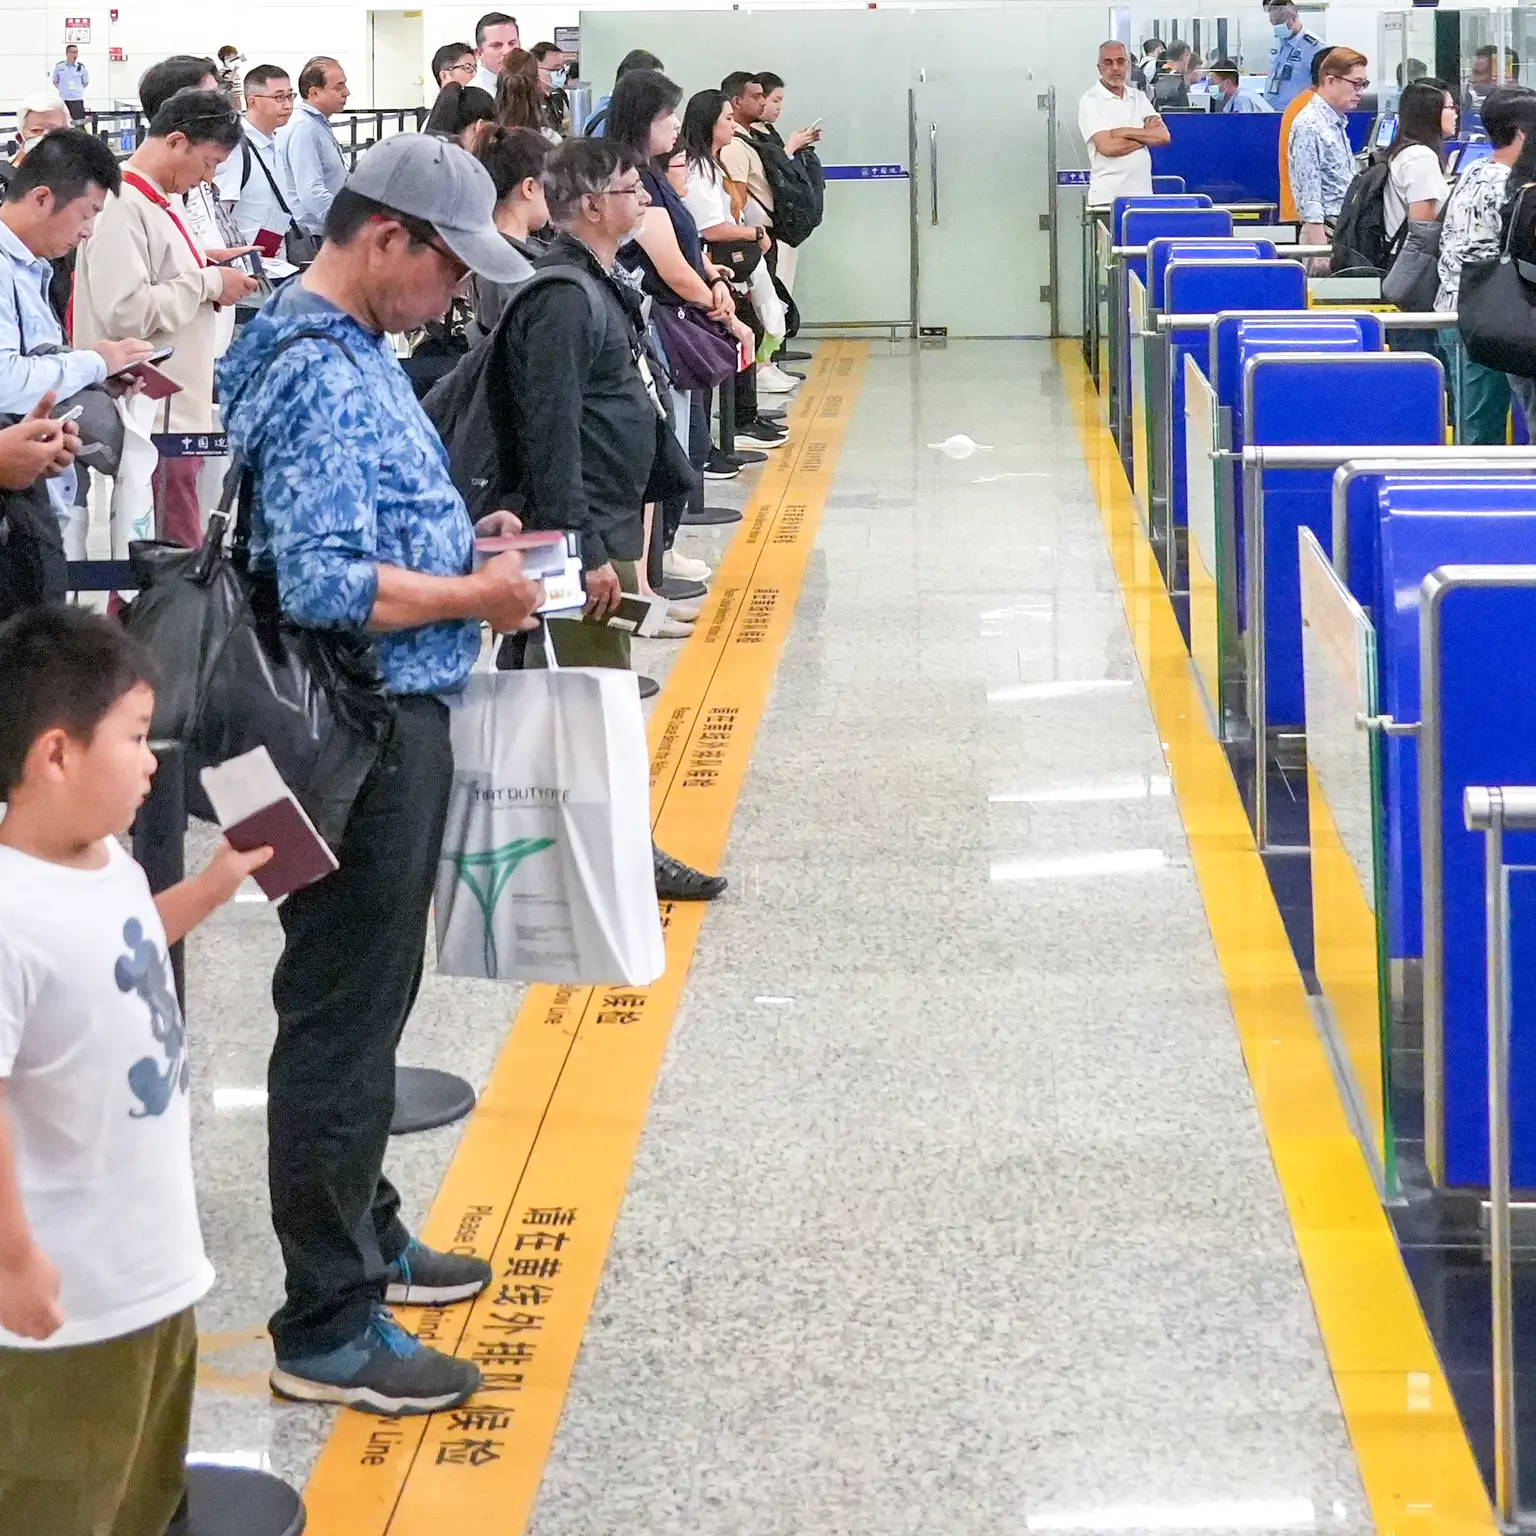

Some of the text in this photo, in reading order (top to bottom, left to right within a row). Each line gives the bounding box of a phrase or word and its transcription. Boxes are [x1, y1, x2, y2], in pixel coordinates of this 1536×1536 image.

[454, 1205, 493, 1243] Please
[435, 1206, 578, 1467] 请在黄线外排队候检
[360, 1430, 404, 1466] Line
